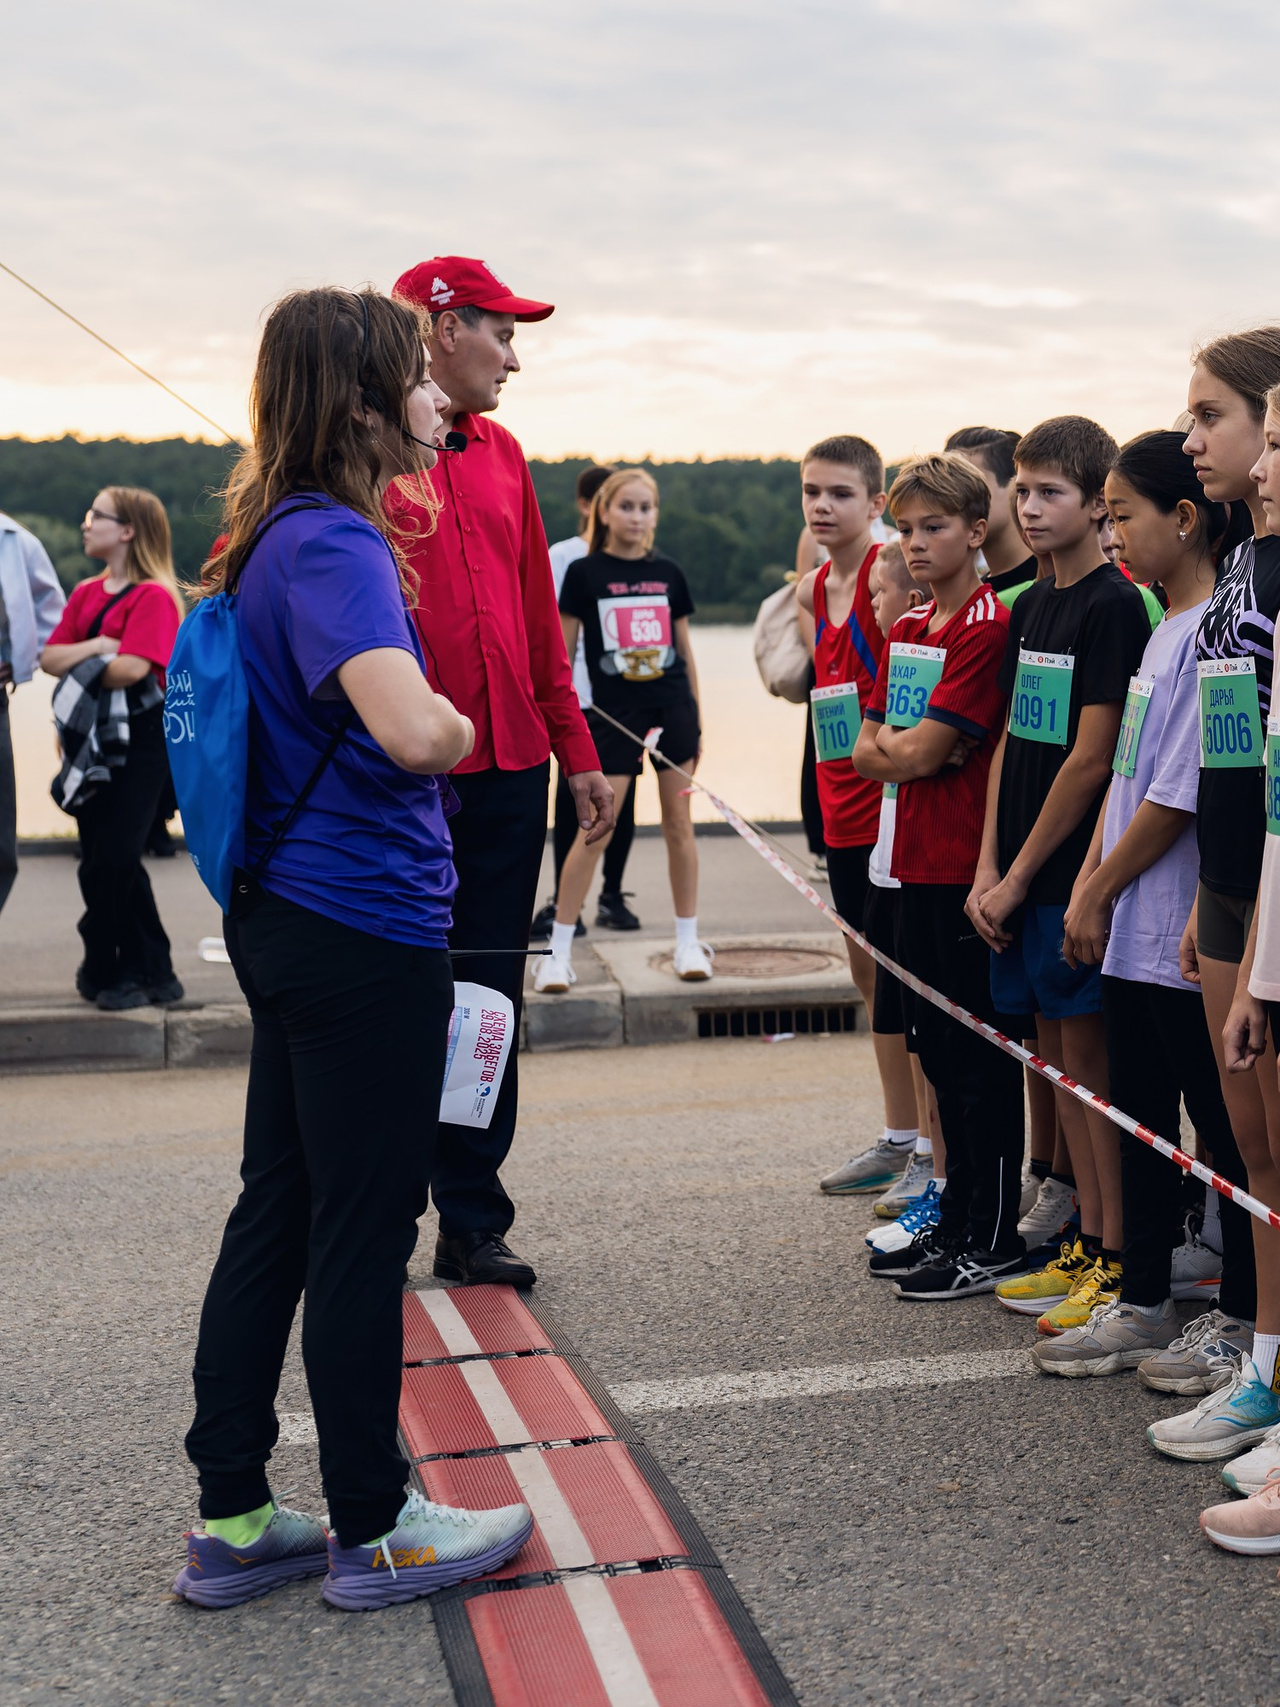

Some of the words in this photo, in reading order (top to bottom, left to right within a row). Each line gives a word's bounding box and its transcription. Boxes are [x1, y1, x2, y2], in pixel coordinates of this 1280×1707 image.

[630, 620, 662, 643] 530
[1021, 673, 1043, 691] ОЛЕГ
[887, 683, 928, 719] 563
[1014, 692, 1057, 732] 4091
[1210, 688, 1235, 708] ДАРЬЯ
[820, 720, 850, 751] 710
[1206, 712, 1253, 754] 5006
[490, 1011, 507, 1042] СХЕМА
[480, 1043, 502, 1083] ЗАБЕГОВ
